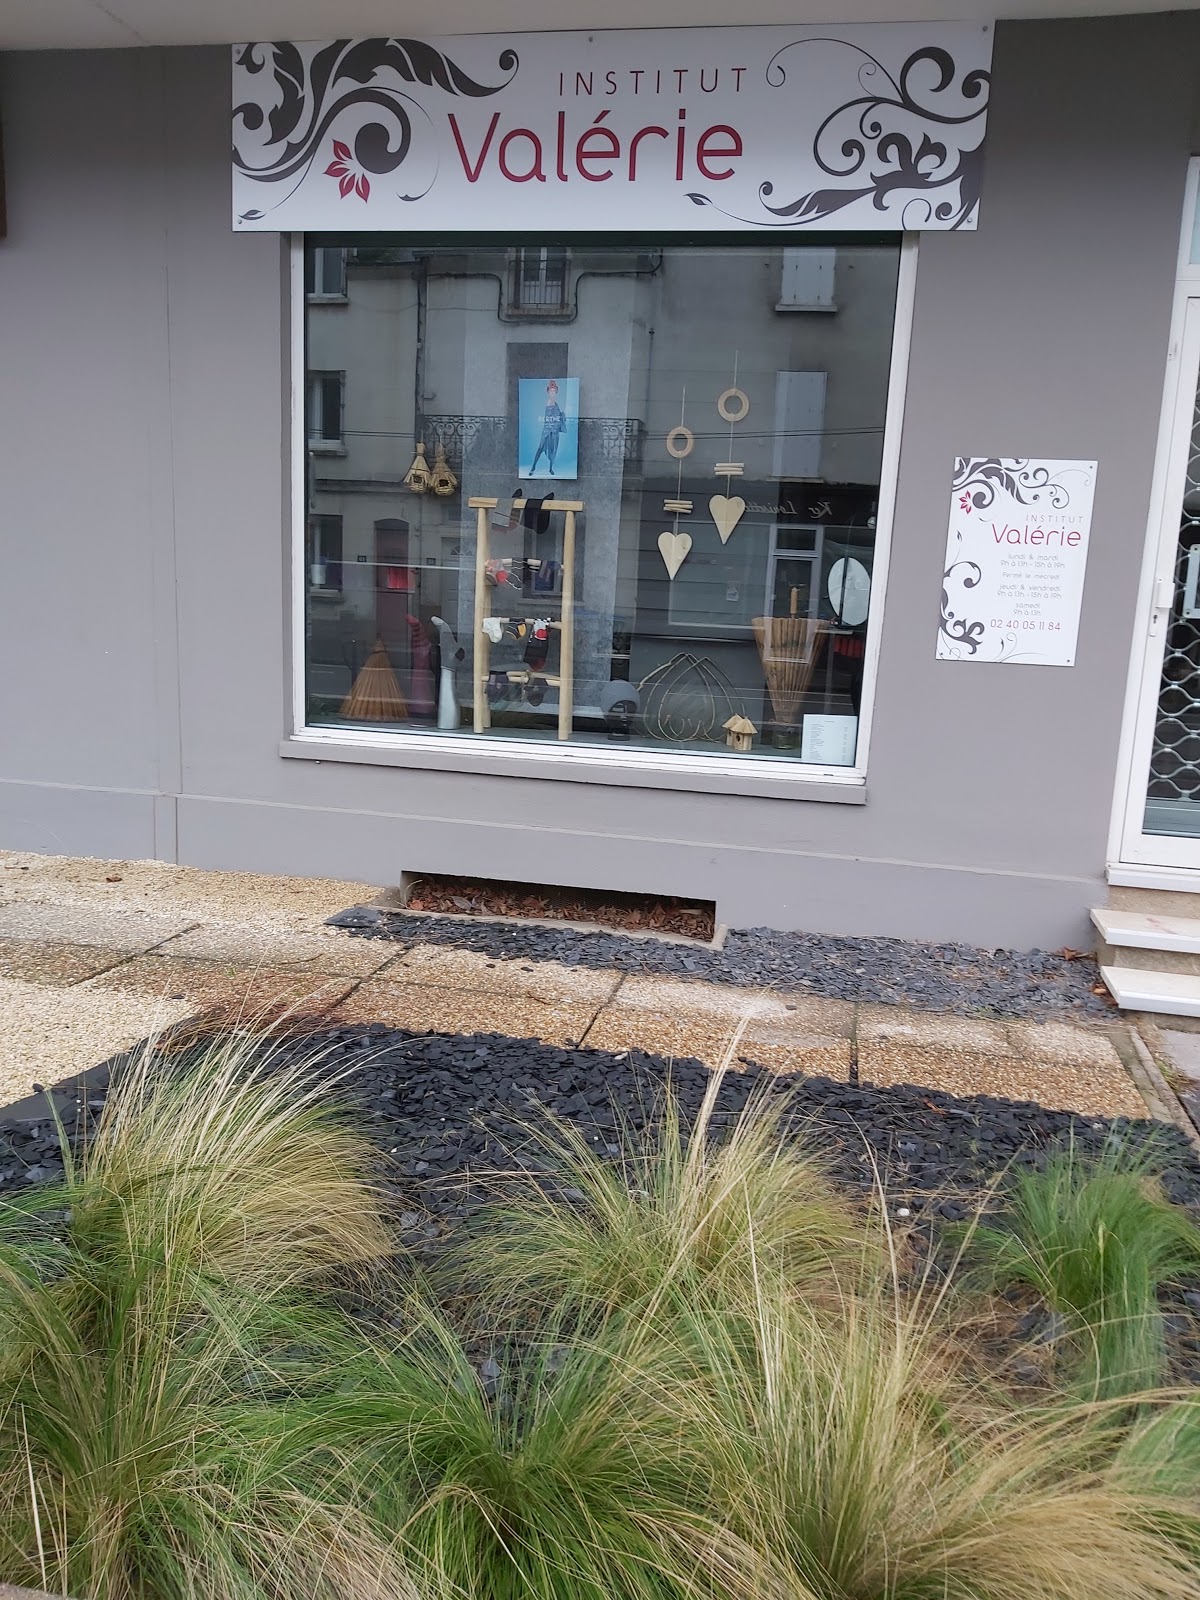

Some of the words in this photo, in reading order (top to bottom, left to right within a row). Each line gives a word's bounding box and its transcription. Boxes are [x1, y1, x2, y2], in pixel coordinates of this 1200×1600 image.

[559, 68, 748, 96] INSTITUT
[447, 108, 743, 183] Valérie
[1025, 514, 1084, 523] INSTITUT
[991, 523, 1081, 547] Valérie
[990, 619, 1003, 628] 02
[1006, 620, 1019, 629] 40
[1022, 620, 1036, 630] 05
[1039, 622, 1044, 630] 11
[1048, 622, 1060, 630] 84
